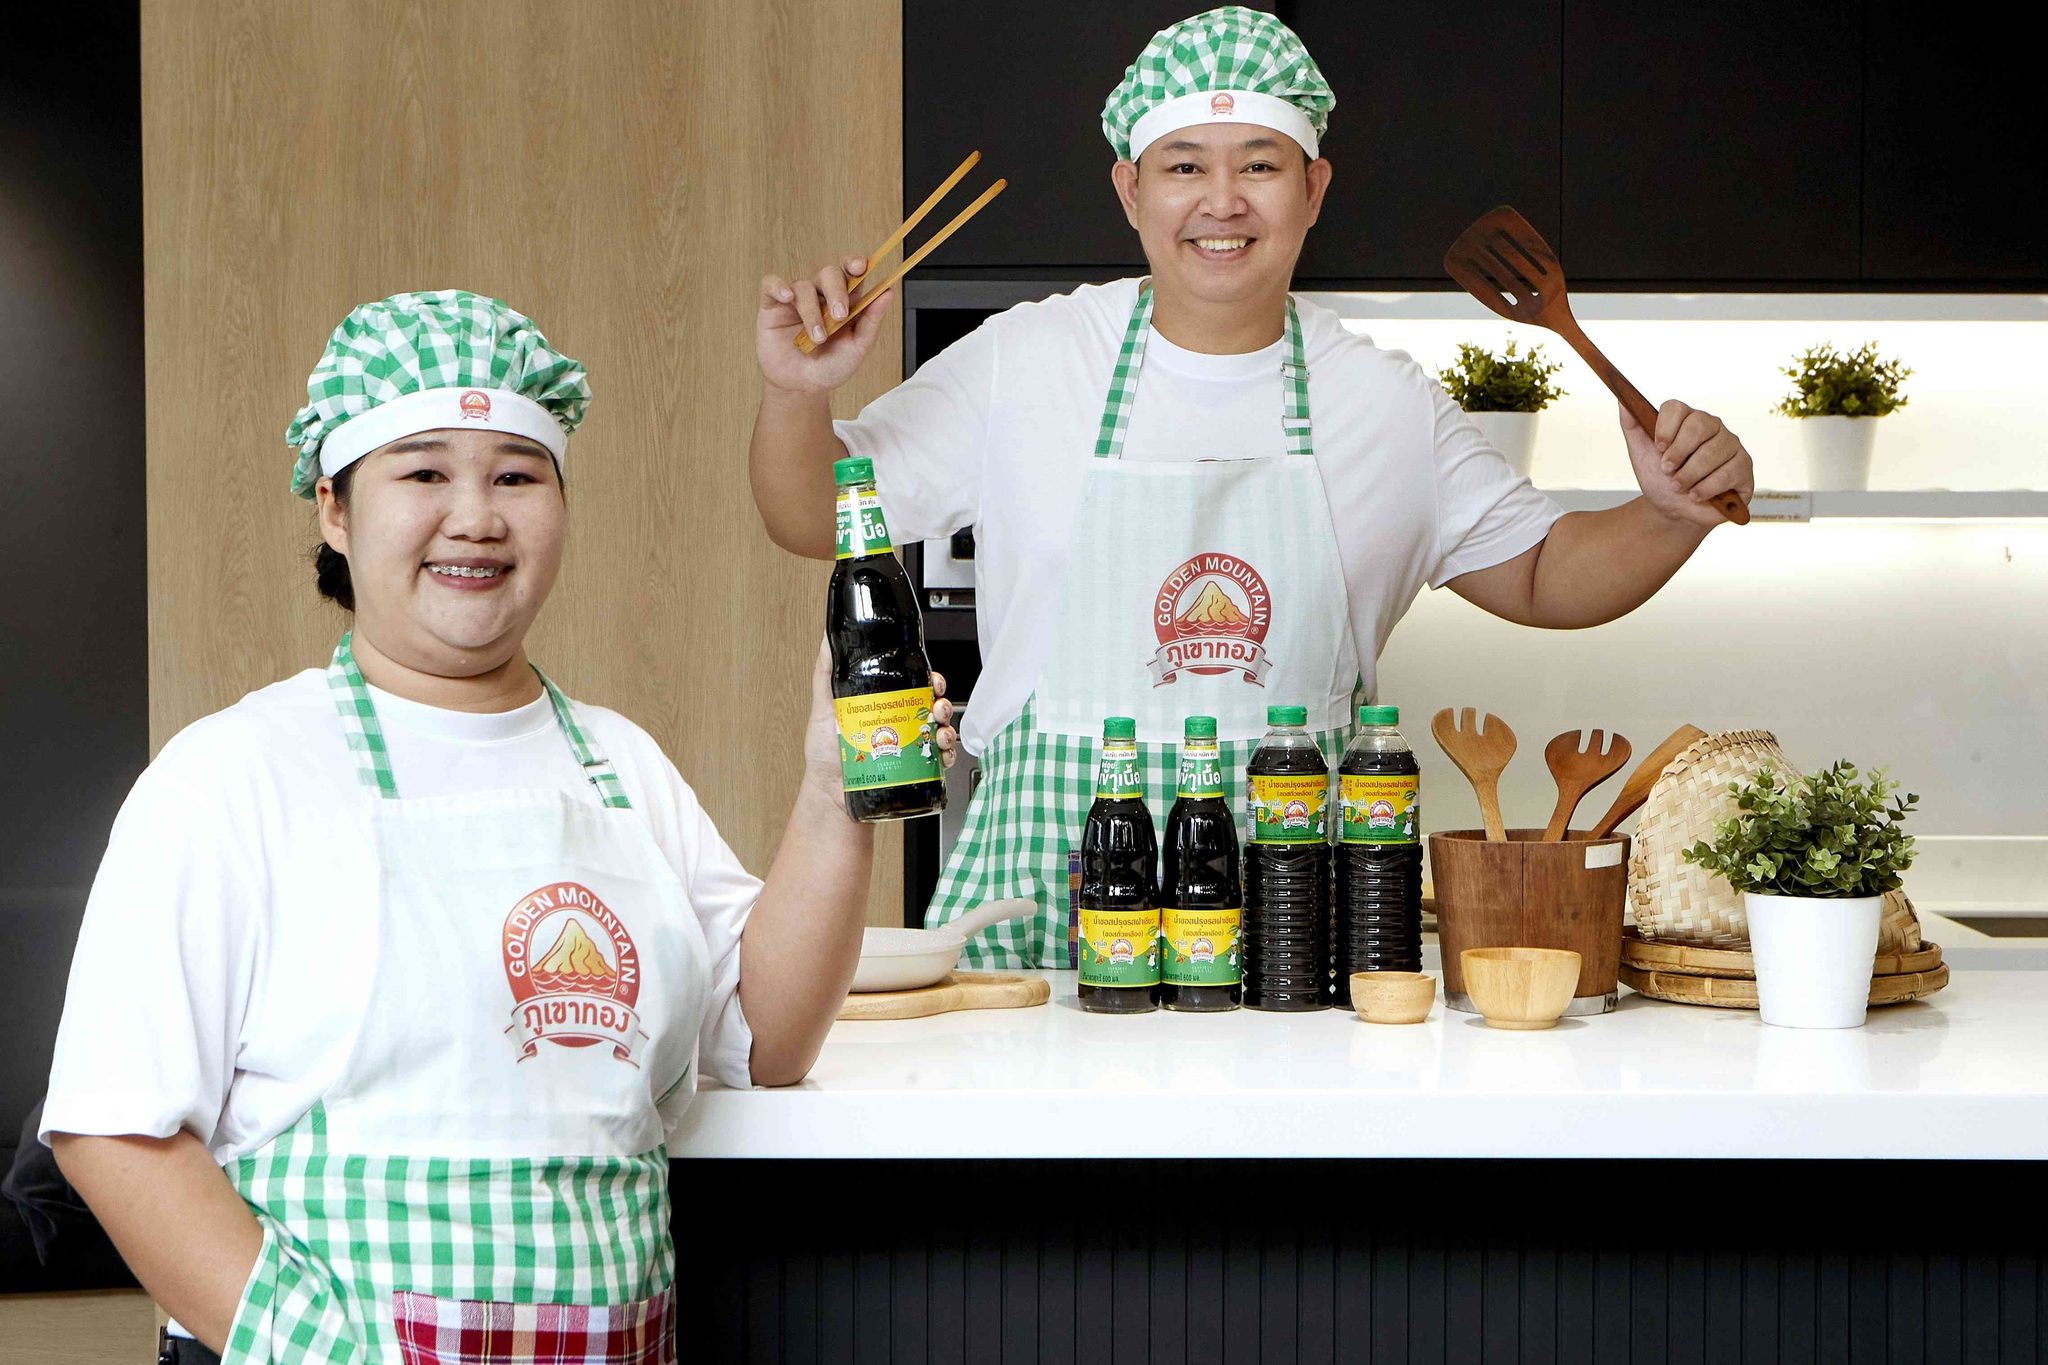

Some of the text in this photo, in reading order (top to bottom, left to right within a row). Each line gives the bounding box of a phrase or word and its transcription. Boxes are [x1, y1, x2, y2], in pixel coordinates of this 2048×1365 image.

[1158, 557, 1267, 626] GOLDEN MOUNTAIN
[1166, 641, 1258, 667] ภูเขาทอง
[866, 774, 877, 784] 600
[506, 887, 636, 984] GOLDEN MOUNTAIN
[523, 1001, 630, 1035] ภูเขาทอง
